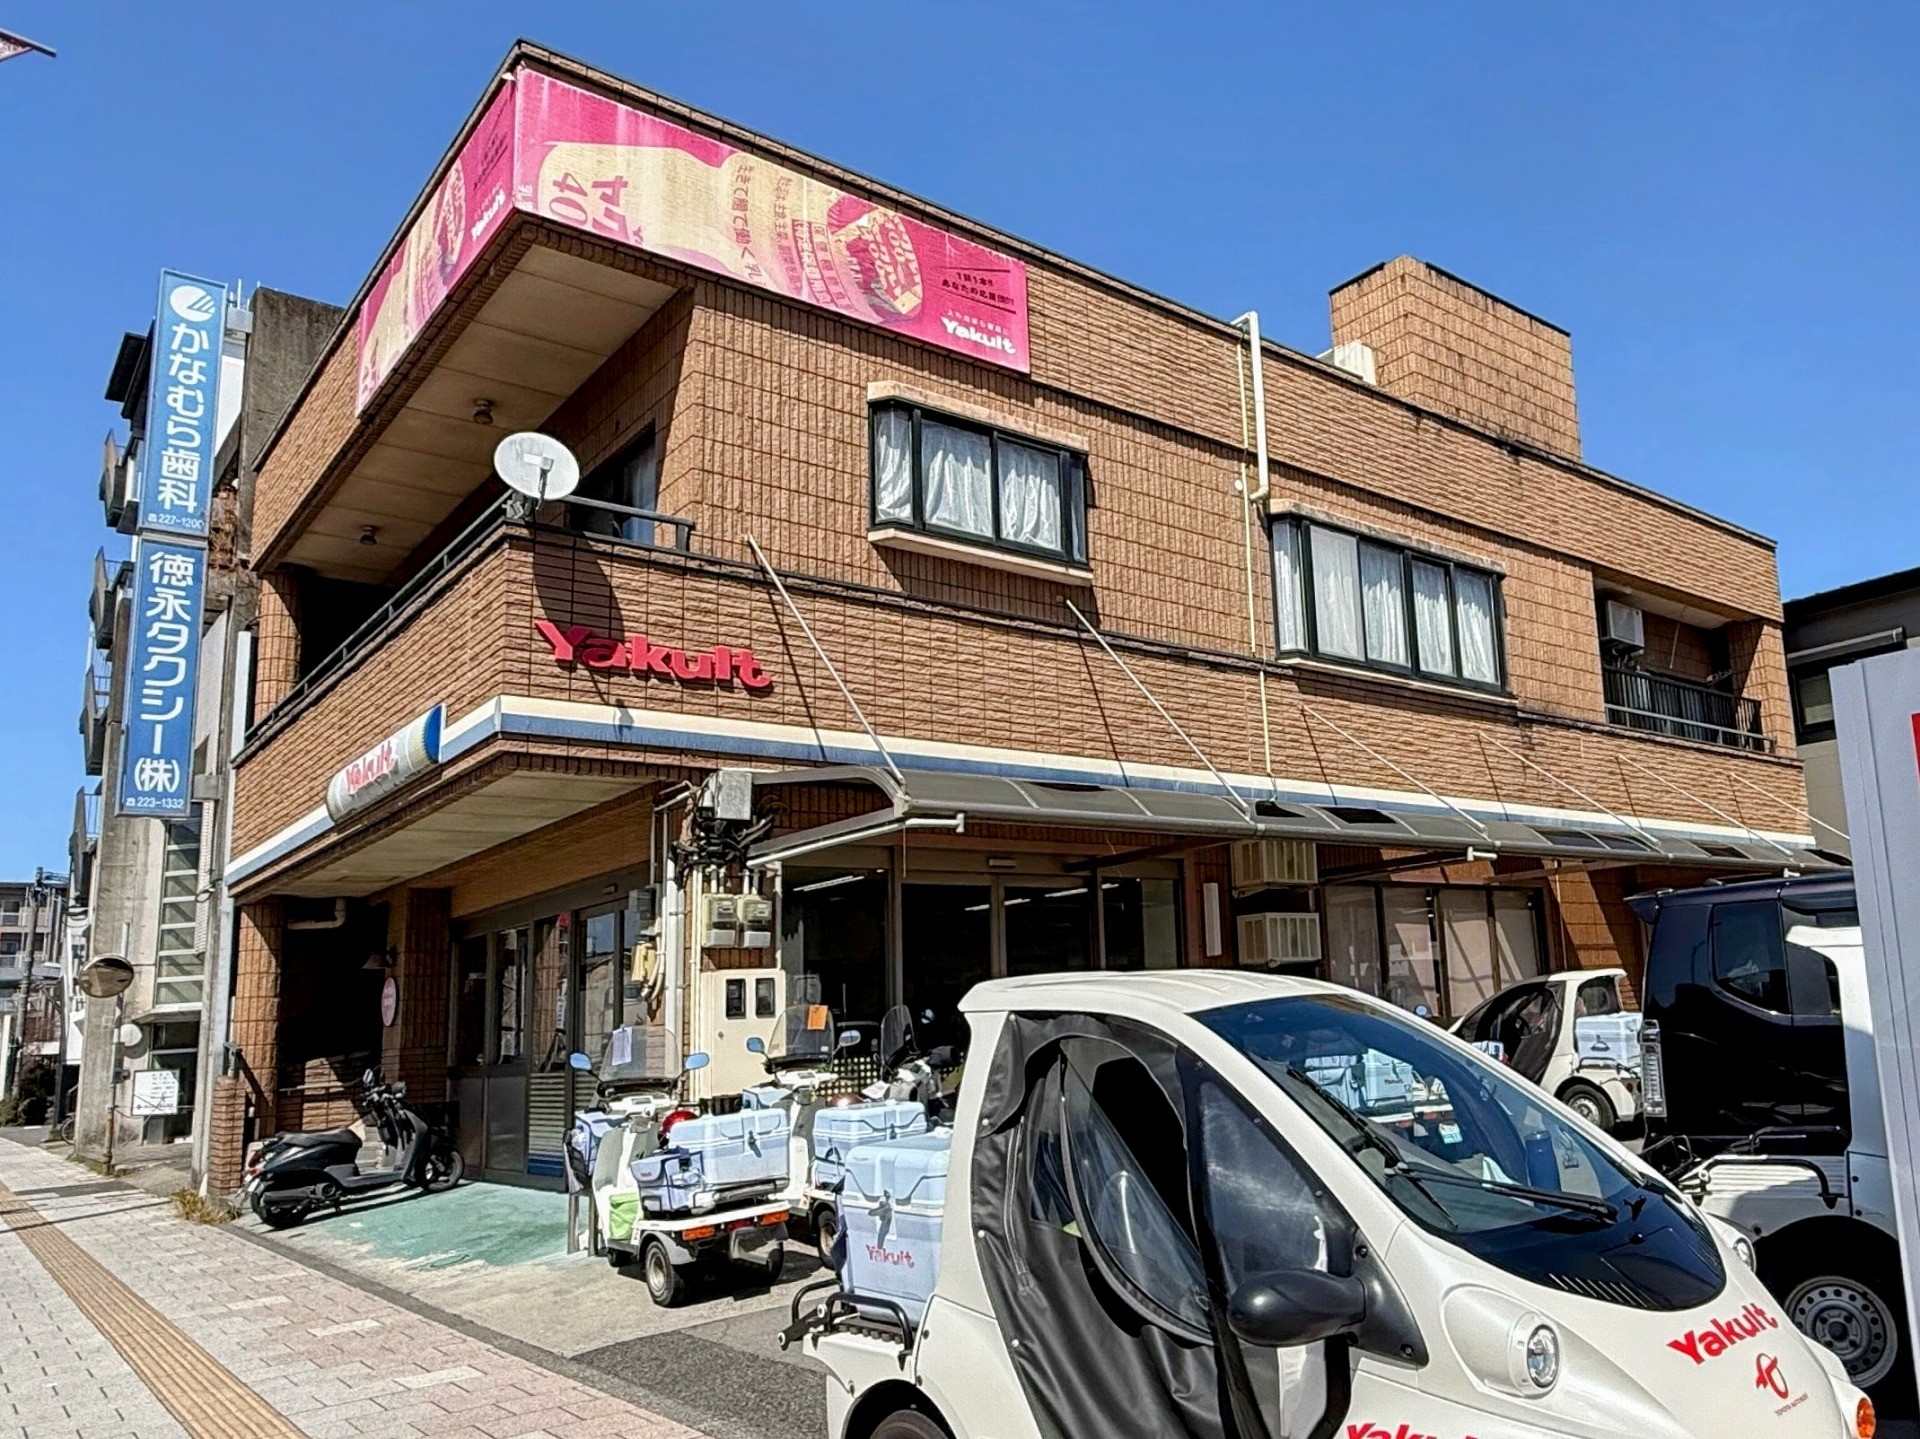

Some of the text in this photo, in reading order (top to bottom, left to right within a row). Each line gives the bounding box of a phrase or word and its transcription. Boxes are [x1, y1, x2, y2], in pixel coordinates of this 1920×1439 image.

[941, 316, 1017, 354] Yakult
[158, 322, 210, 514] かなむら歯科
[159, 513, 205, 529] 227-1200
[133, 551, 196, 793] 徳永タクシー(株)
[534, 619, 772, 687] Yakult
[137, 796, 184, 809] 223-1332
[865, 1244, 915, 1269] Yakult
[1666, 1302, 1779, 1365] Yakult
